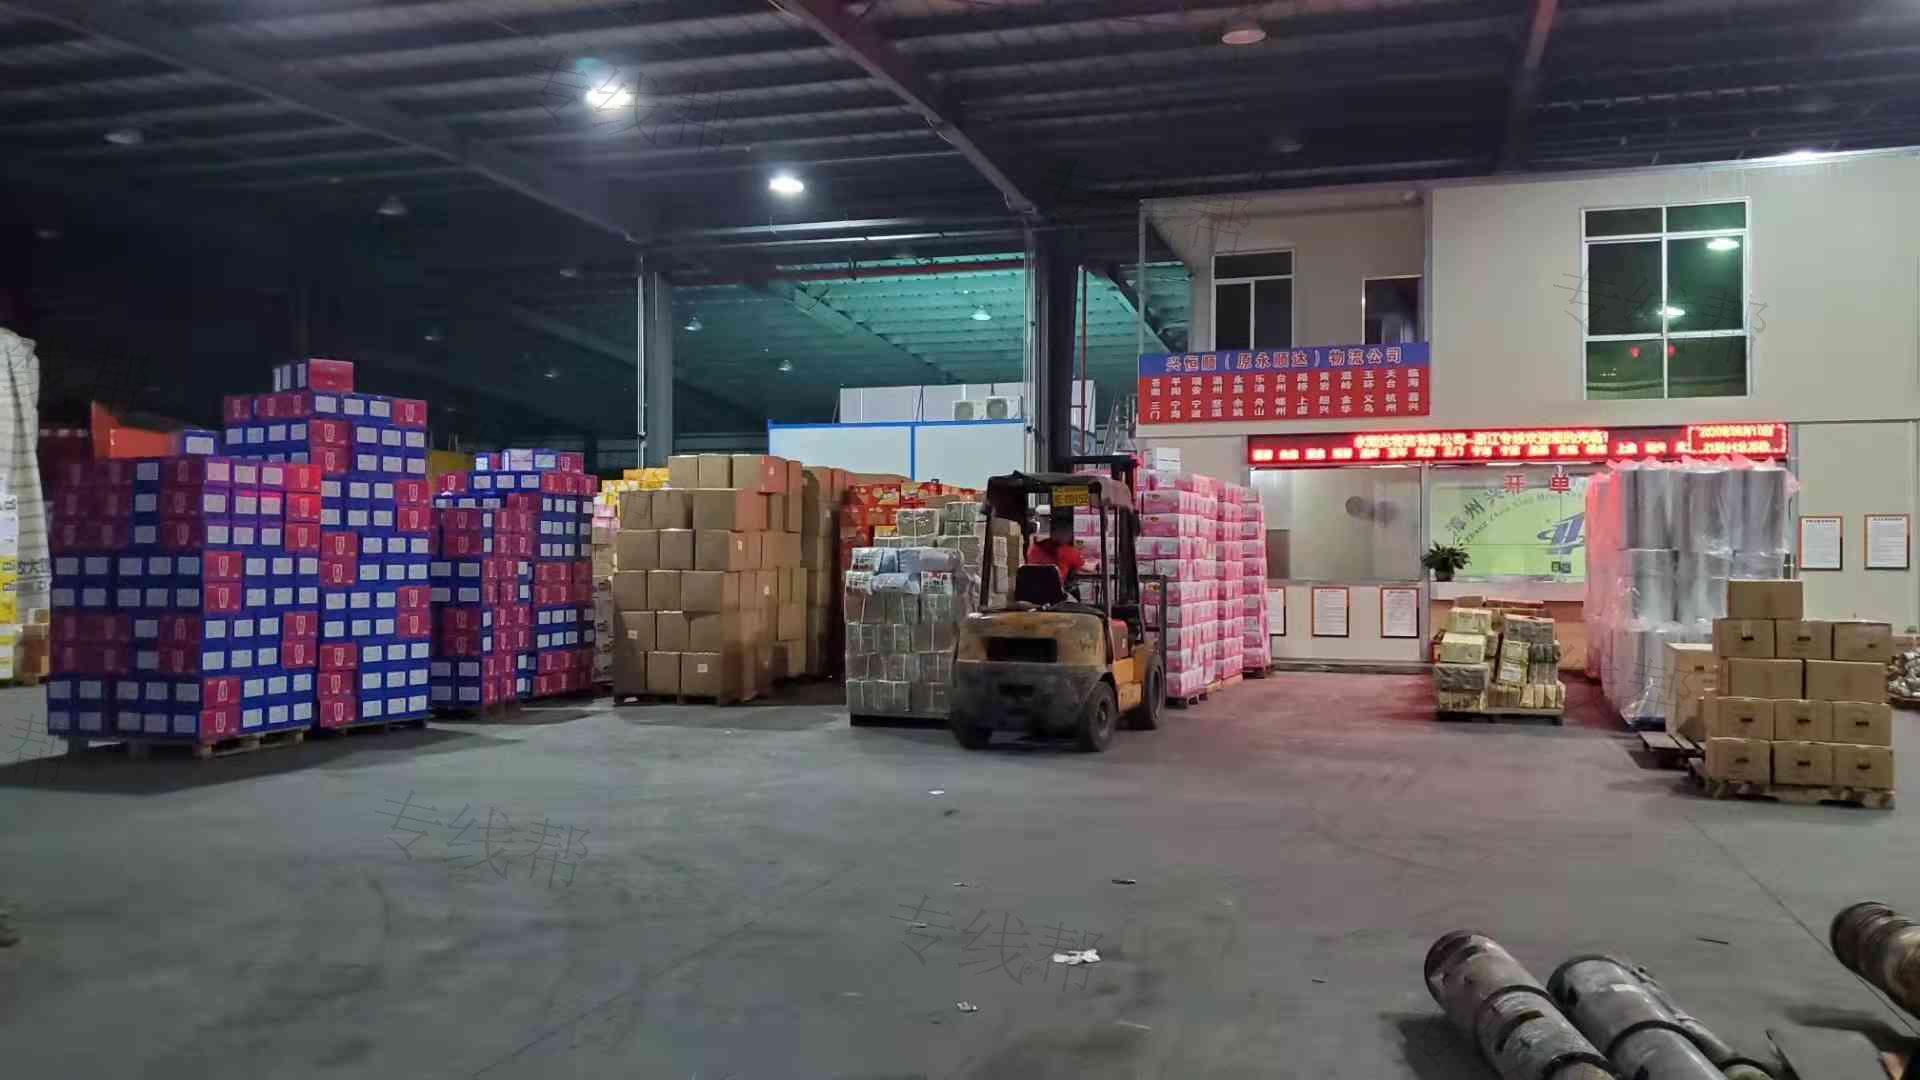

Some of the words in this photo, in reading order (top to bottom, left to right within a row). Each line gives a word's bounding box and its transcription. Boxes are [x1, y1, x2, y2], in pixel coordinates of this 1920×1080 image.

[1384, 369, 1396, 388] 天台
[1150, 401, 1160, 420] 三门
[1254, 398, 1264, 416] 舟山
